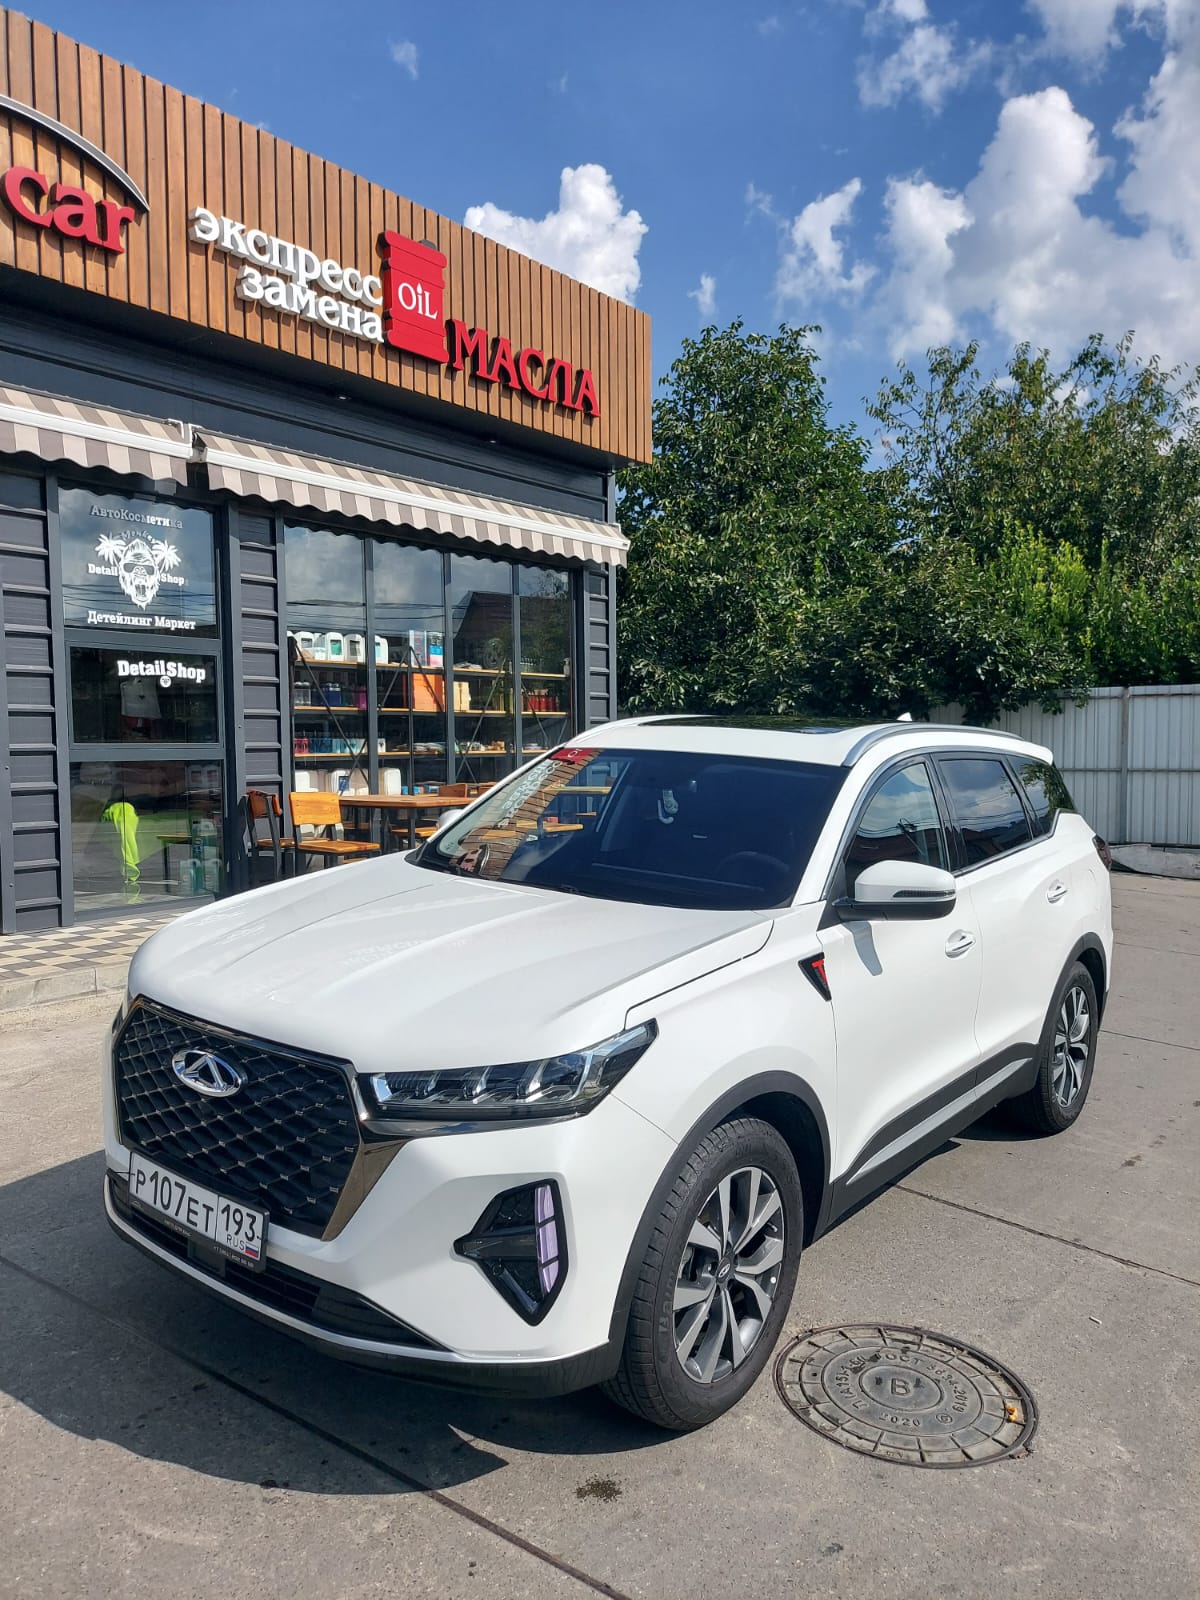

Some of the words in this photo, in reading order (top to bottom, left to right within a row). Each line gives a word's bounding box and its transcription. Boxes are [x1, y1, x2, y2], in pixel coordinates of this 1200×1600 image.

[4, 166, 135, 254] car
[190, 206, 384, 307] экспресс
[237, 264, 385, 344] замена
[398, 282, 438, 320] OiL
[449, 318, 601, 417] МАСЛА
[91, 504, 183, 529] АвтоКосметика
[88, 564, 118, 577] Detail
[161, 574, 185, 586] Shop
[87, 611, 153, 627] Детейлинг
[154, 616, 196, 631] Маркет
[221, 1204, 257, 1242] 193
[226, 1234, 245, 1251] RUS
[889, 1377, 911, 1397] В
